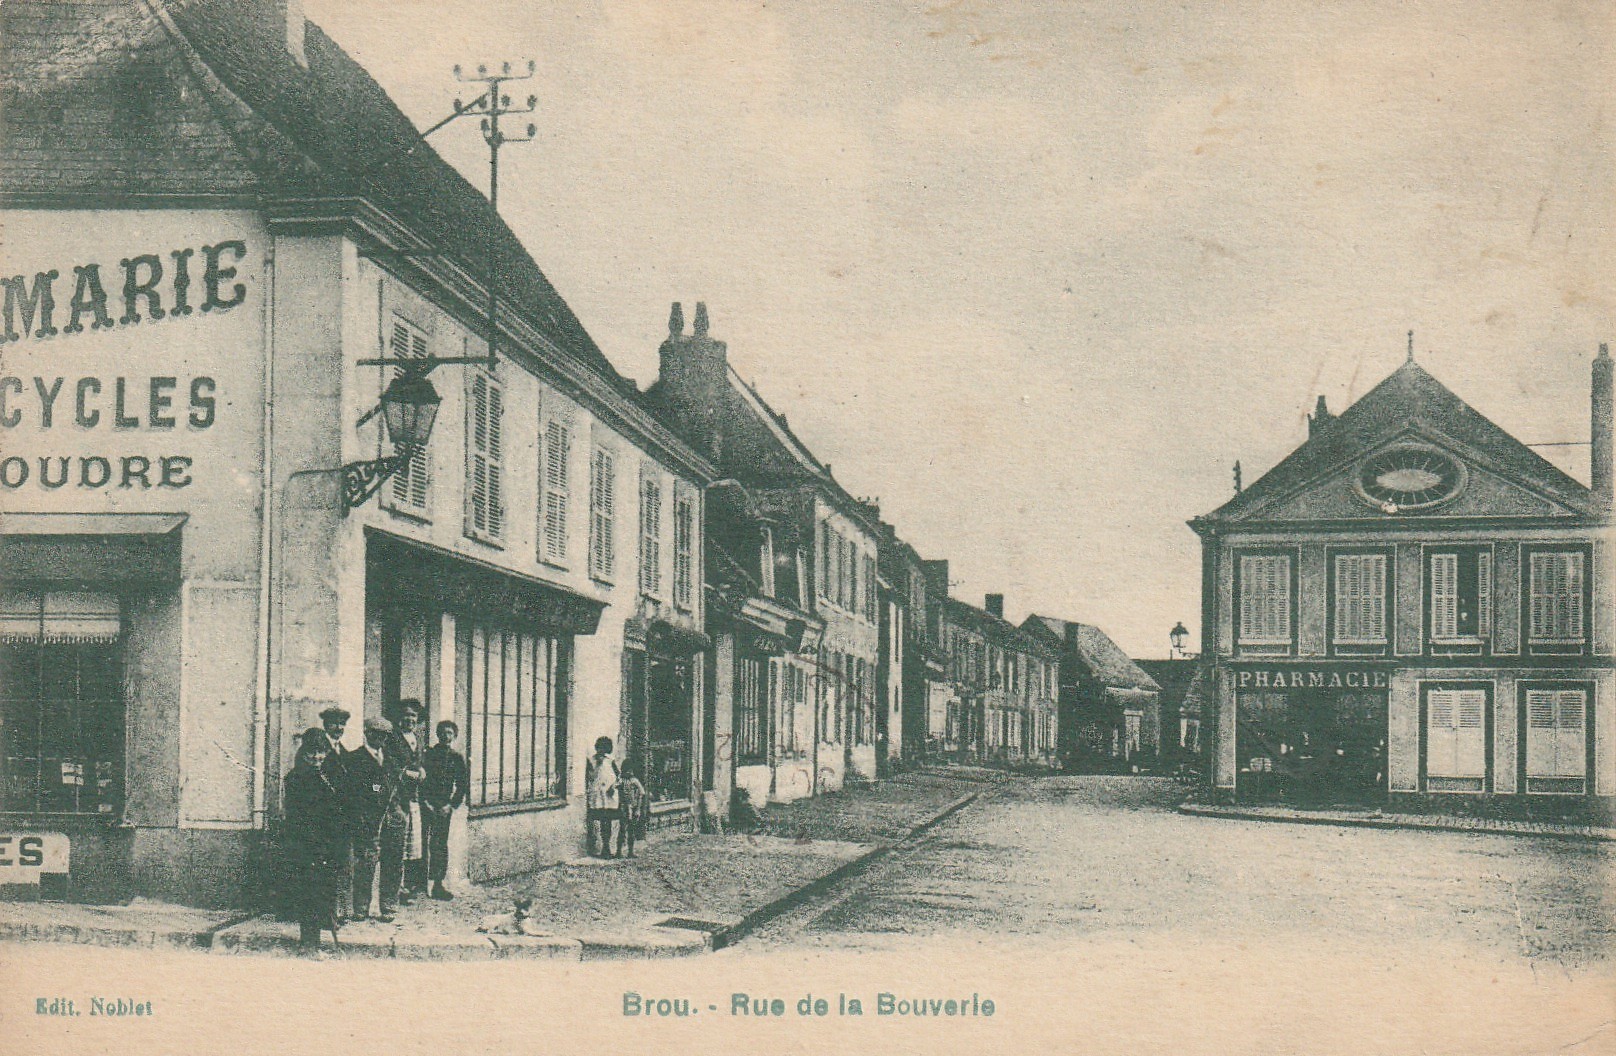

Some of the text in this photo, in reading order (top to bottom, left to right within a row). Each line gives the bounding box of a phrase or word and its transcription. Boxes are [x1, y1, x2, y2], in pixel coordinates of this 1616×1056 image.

[0, 376, 216, 428] CYCLES
[0, 456, 193, 489] OUDRE
[1239, 671, 1386, 688] PHARMACIE
